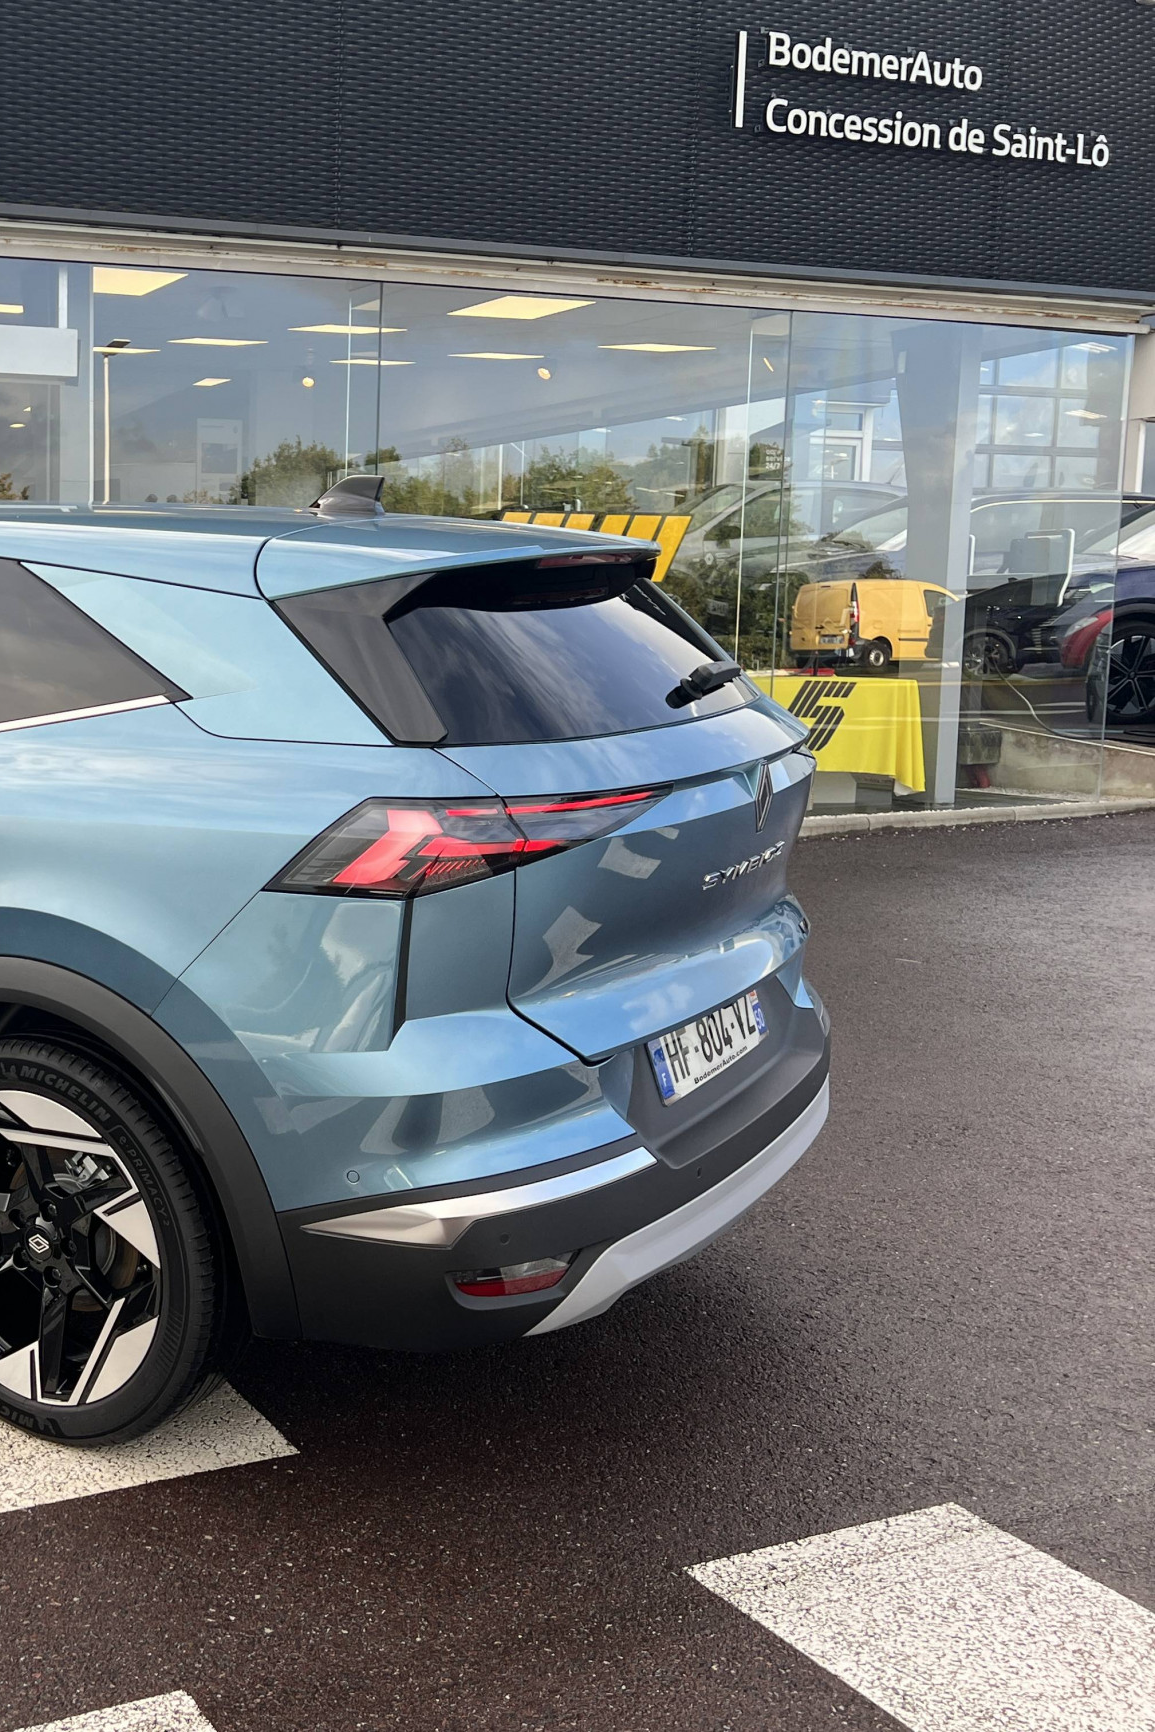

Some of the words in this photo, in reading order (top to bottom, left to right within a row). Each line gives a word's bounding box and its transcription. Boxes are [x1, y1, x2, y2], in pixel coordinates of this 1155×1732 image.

[768, 31, 983, 91] BodemerAuto
[765, 98, 941, 150] Concession
[948, 118, 986, 154] de
[992, 124, 1110, 168] Saint-Lô
[754, 1007, 766, 1030] 50
[661, 1072, 668, 1087] F
[693, 1046, 748, 1084] BodemerAuto.com
[20, 1065, 112, 1122] MICHELIN
